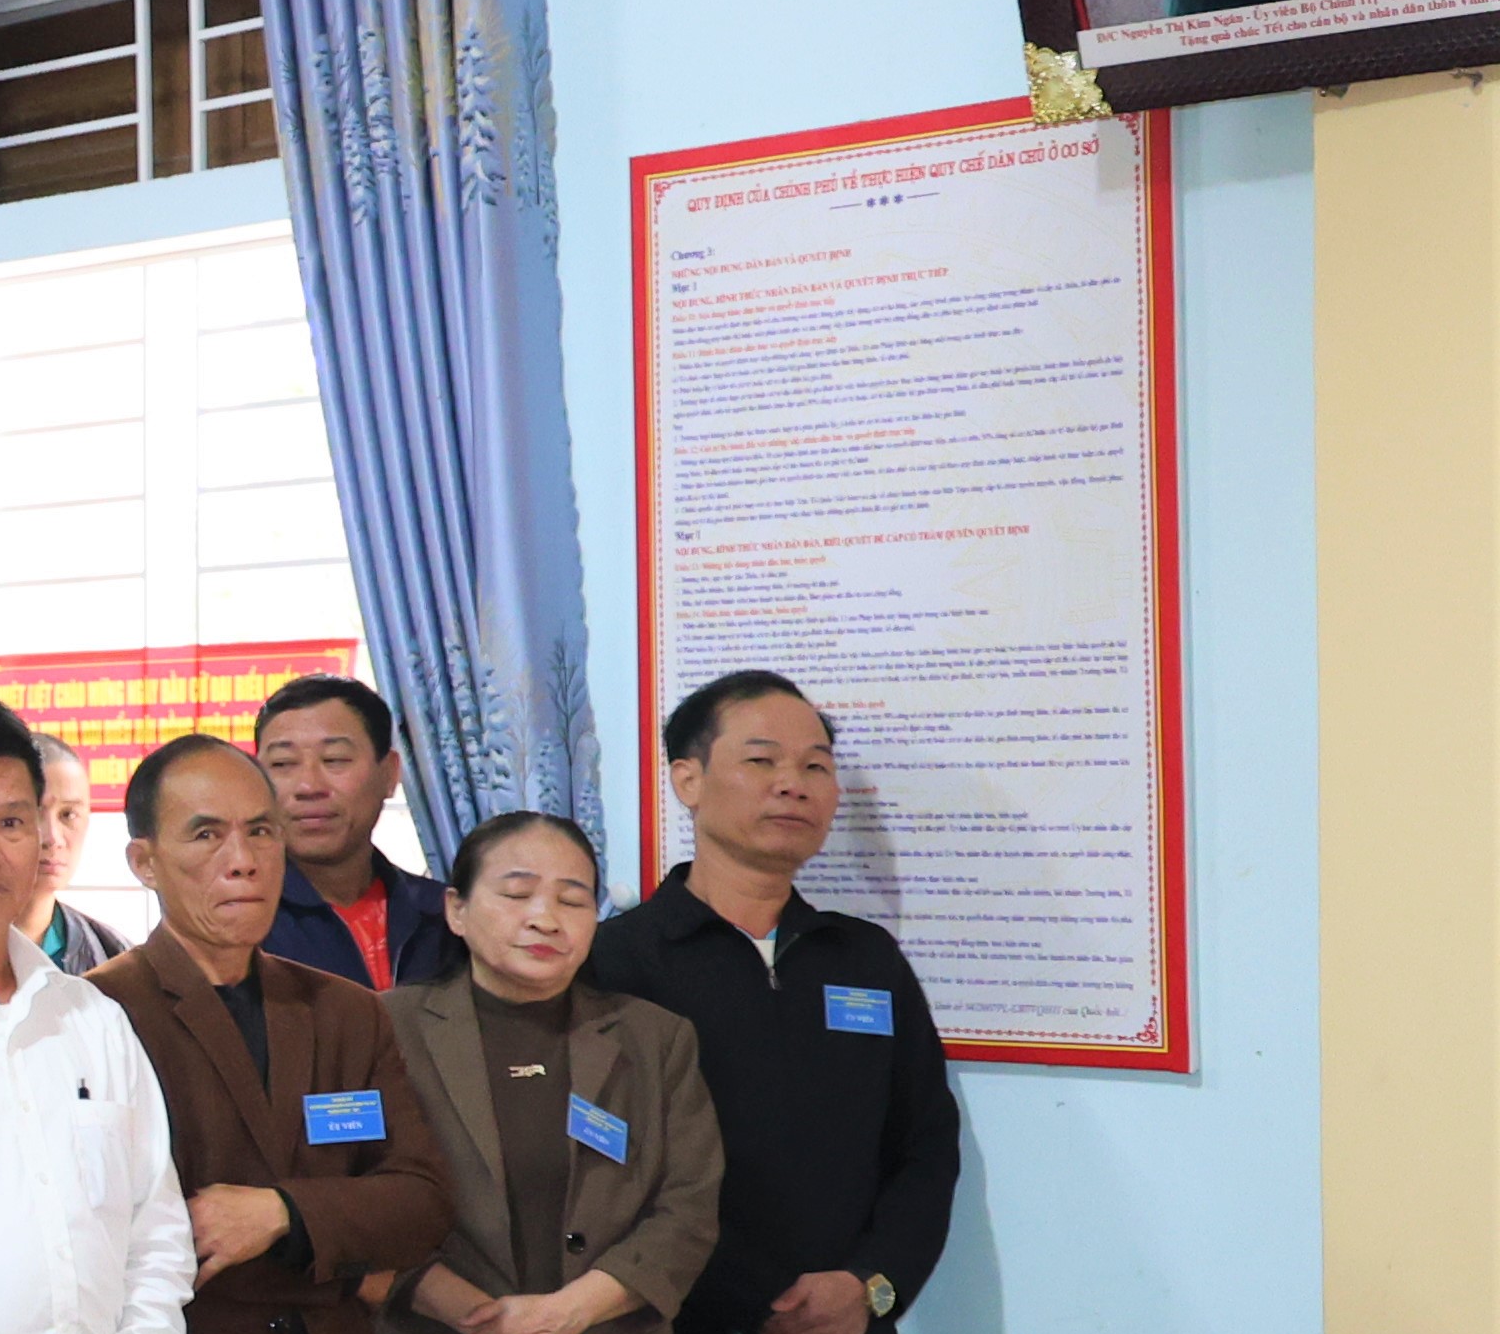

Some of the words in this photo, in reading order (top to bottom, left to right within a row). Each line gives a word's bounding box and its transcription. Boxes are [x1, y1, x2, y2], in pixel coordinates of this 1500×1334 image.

[1121, 24, 1164, 41] Nguyễn
[1165, 21, 1185, 34] Thị
[1186, 17, 1211, 32] Kim
[1213, 14, 1244, 28] Ngân
[1272, 4, 1298, 17] viên
[1300, 2, 1317, 16] Bộ
[1179, 34, 1209, 47] Tặng
[1211, 29, 1231, 43] quà
[1234, 24, 1261, 38] chúc
[1264, 21, 1284, 34] Tết
[1286, 19, 1308, 31] cho
[1310, 15, 1331, 28] cán
[1333, 11, 1349, 26] bộ
[1351, 11, 1366, 22] và
[1369, 5, 1399, 19] nhân
[1402, 2, 1425, 14] dân
[686, 197, 712, 214] QUY
[746, 184, 771, 206] CỦA
[773, 184, 811, 202] CHÍNH
[813, 172, 839, 197] PHỦ
[861, 171, 893, 191] THỰC
[929, 161, 956, 180] QUY
[959, 149, 986, 177] CHẾ
[988, 151, 1015, 171] DÂN
[1018, 140, 1044, 166] CHỦ
